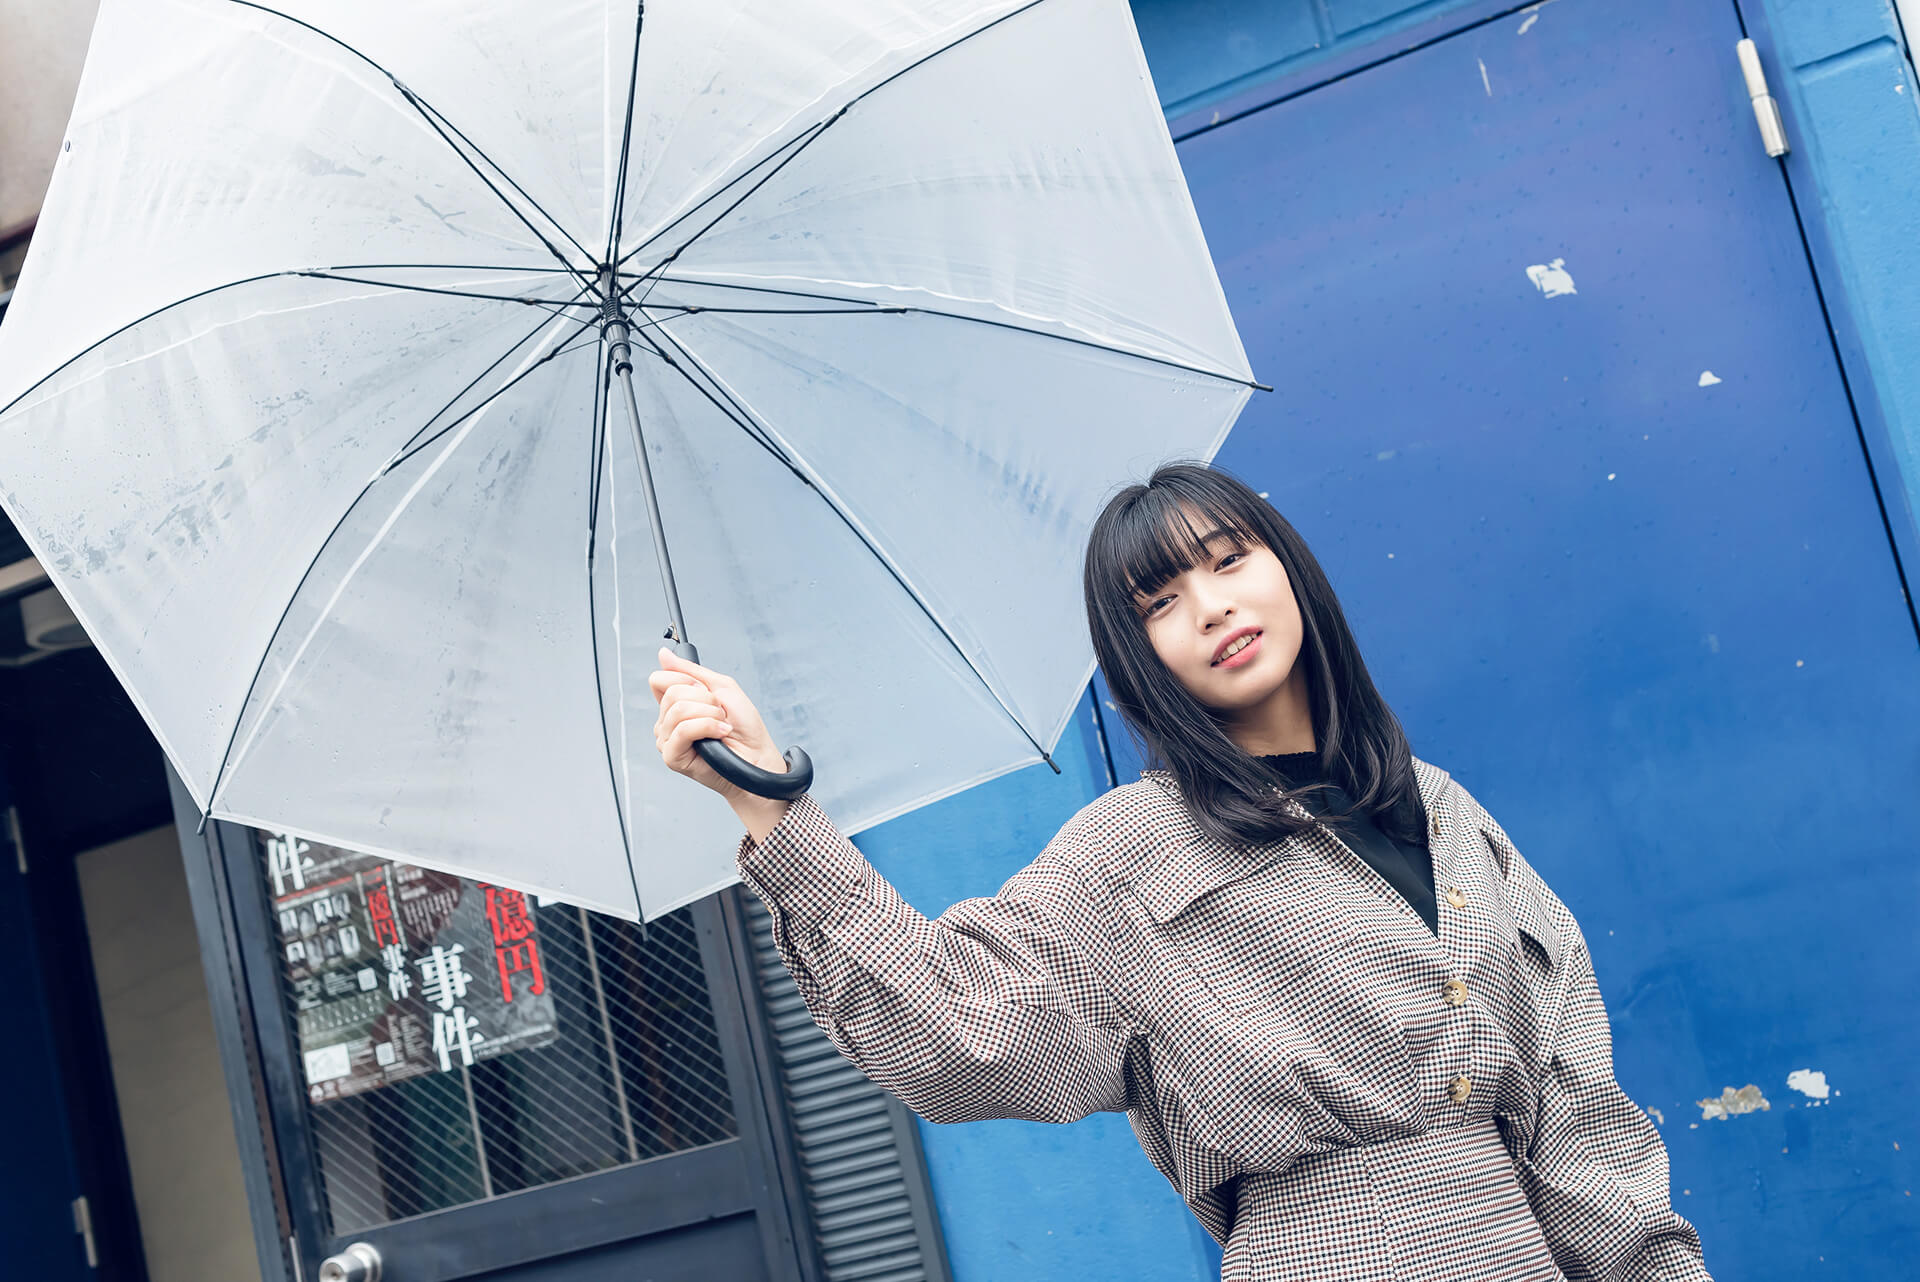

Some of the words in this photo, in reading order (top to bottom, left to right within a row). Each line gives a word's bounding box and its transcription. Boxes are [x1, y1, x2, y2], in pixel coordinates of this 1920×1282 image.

[267, 831, 315, 896] 件
[477, 883, 545, 1003] 億円
[414, 943, 484, 1072] 事件
